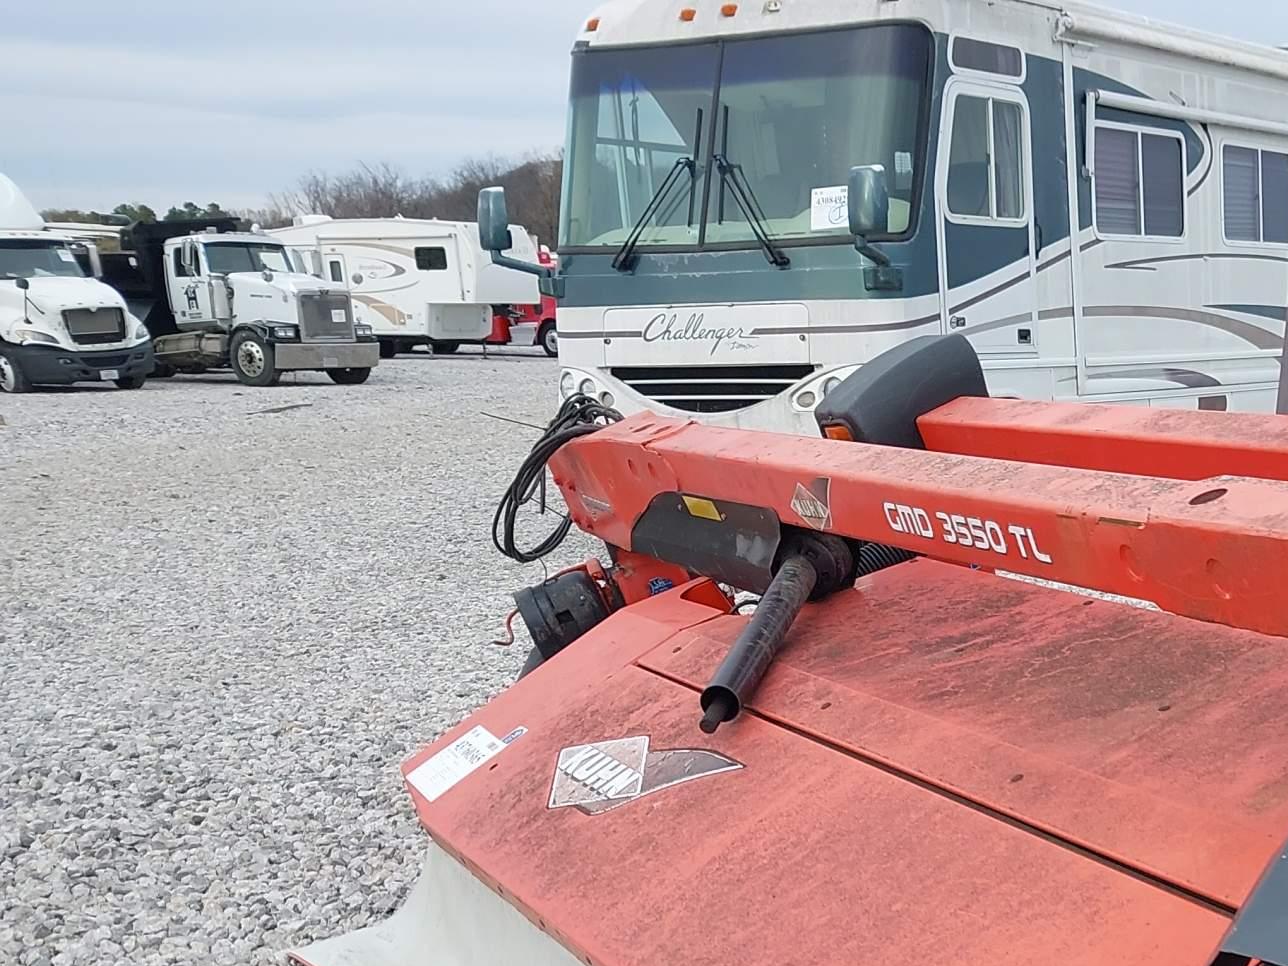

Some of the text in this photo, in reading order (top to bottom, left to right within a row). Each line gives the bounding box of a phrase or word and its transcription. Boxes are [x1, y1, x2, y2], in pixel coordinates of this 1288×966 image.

[643, 313, 760, 356] Challenger
[794, 499, 826, 518] KUHN
[884, 502, 1053, 564] GMD 3550 TL
[559, 745, 641, 798] KUHN
